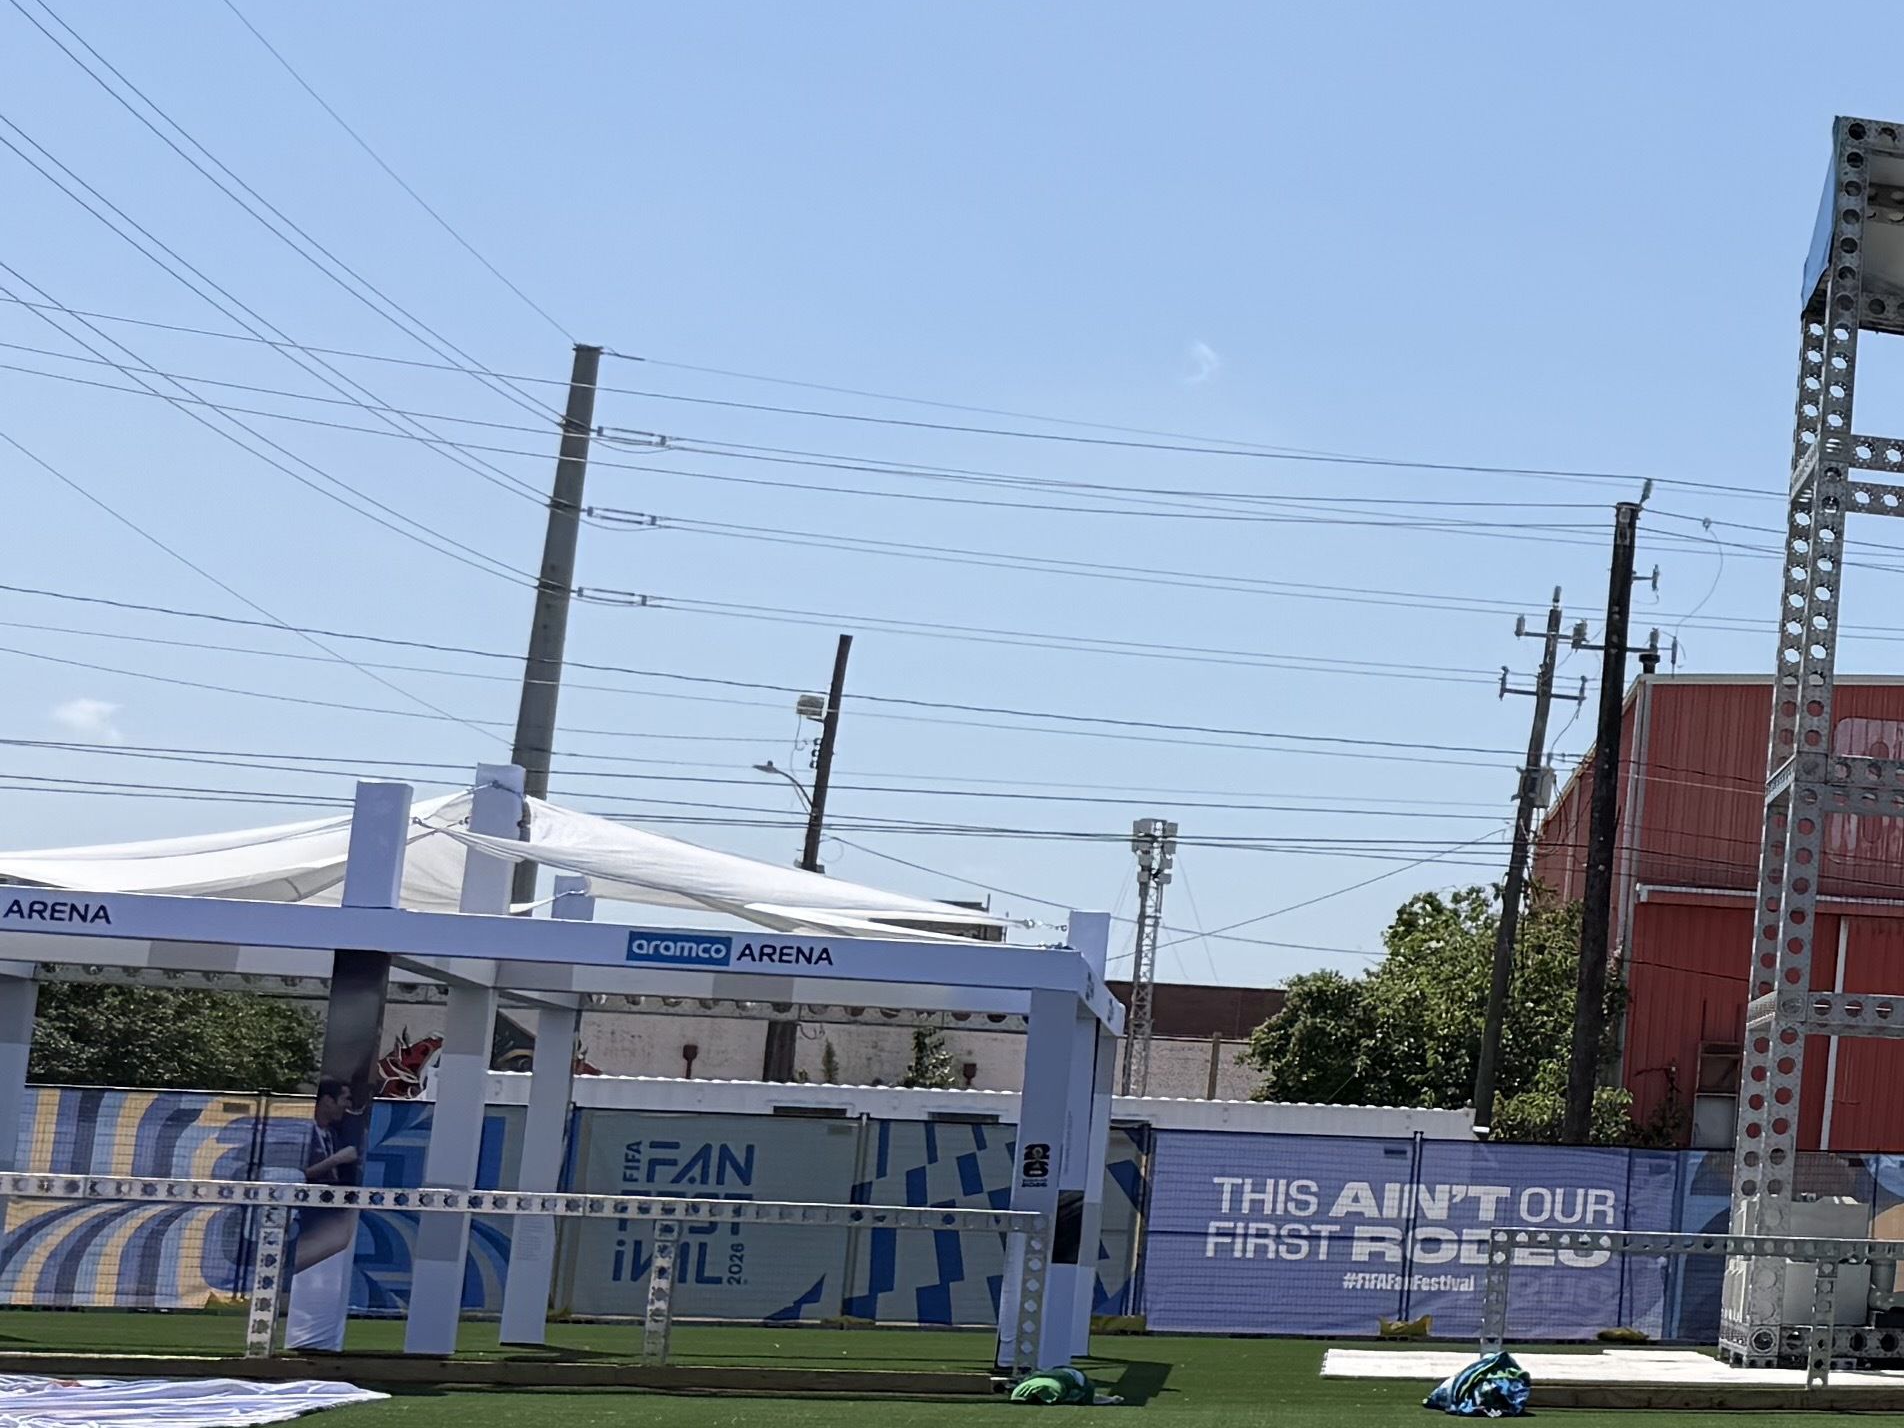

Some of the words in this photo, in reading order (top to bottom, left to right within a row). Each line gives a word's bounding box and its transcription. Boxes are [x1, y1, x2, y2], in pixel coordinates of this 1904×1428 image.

[3, 899, 112, 925] ARENA
[632, 939, 727, 960] aramco
[736, 943, 834, 966] ARENA
[622, 1140, 643, 1183] FIFA
[646, 1140, 756, 1187] FAN
[1213, 1176, 1320, 1217] THIS
[1328, 1181, 1511, 1222] AIN'T
[1519, 1187, 1616, 1225] OUR
[1205, 1221, 1341, 1261] FIRST
[727, 1242, 745, 1286] 2026
